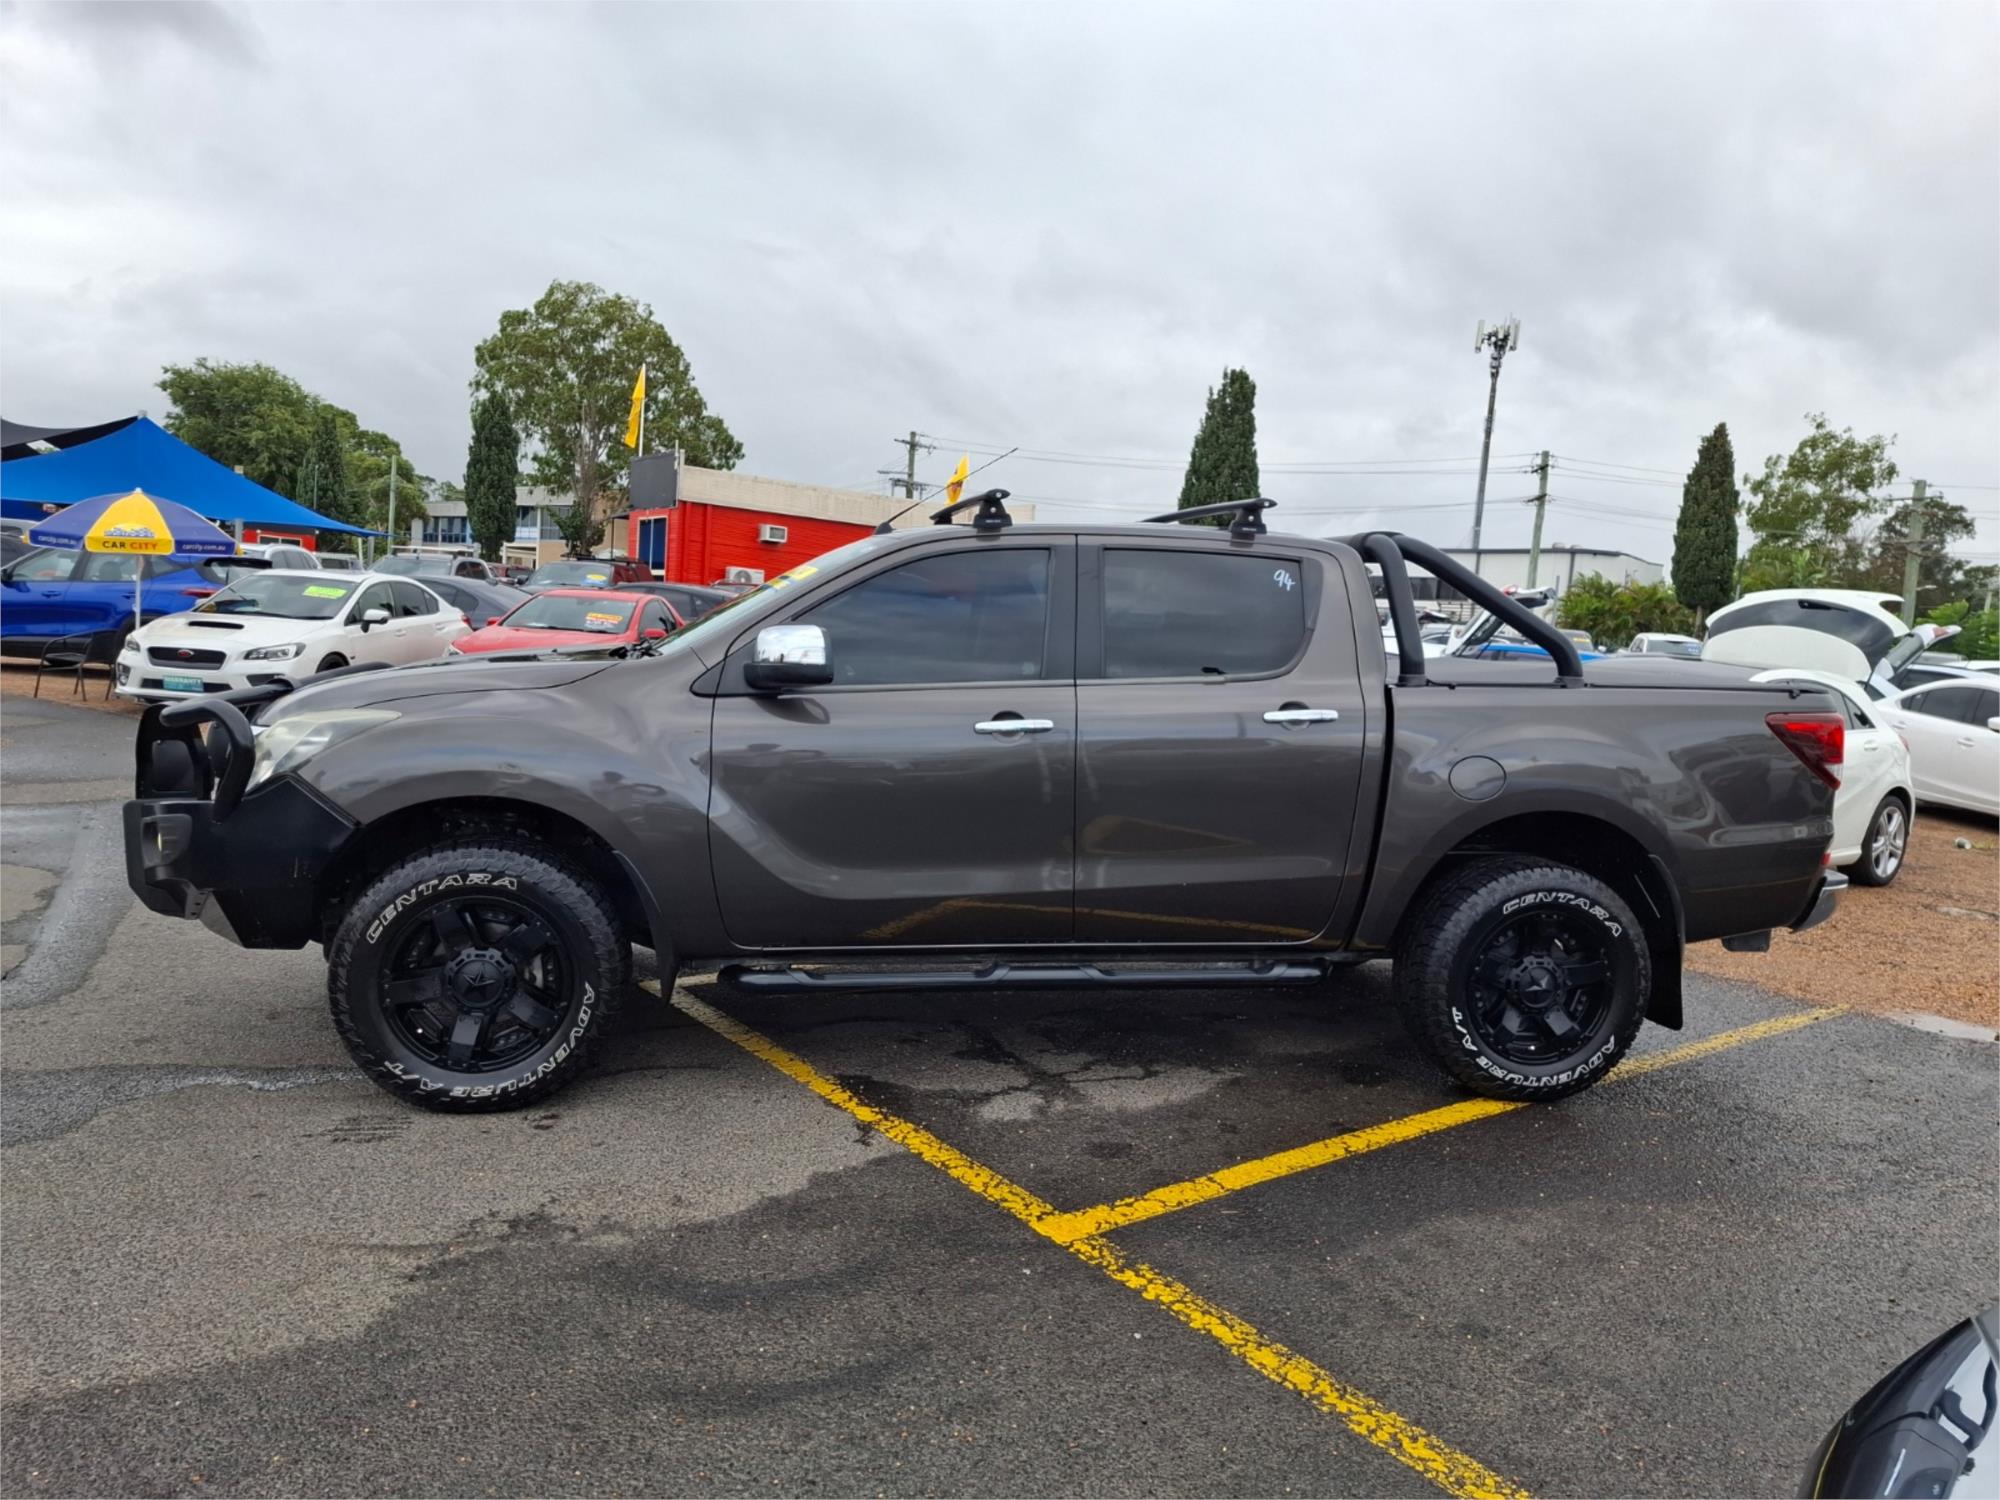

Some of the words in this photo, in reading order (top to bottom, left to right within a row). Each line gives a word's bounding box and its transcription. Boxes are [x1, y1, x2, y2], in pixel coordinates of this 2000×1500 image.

[102, 541, 126, 549] CAR
[129, 542, 158, 550] CITY
[182, 543, 226, 552] carcity.com.au
[1273, 569, 1296, 591] 94
[366, 873, 518, 944] CENTARA
[1503, 891, 1622, 937] CENTARA
[450, 981, 595, 1097] ADVENTURE
[1452, 1006, 1478, 1051] A/T
[384, 1060, 444, 1091] A/T
[1476, 1035, 1615, 1087] ADVENTURE
